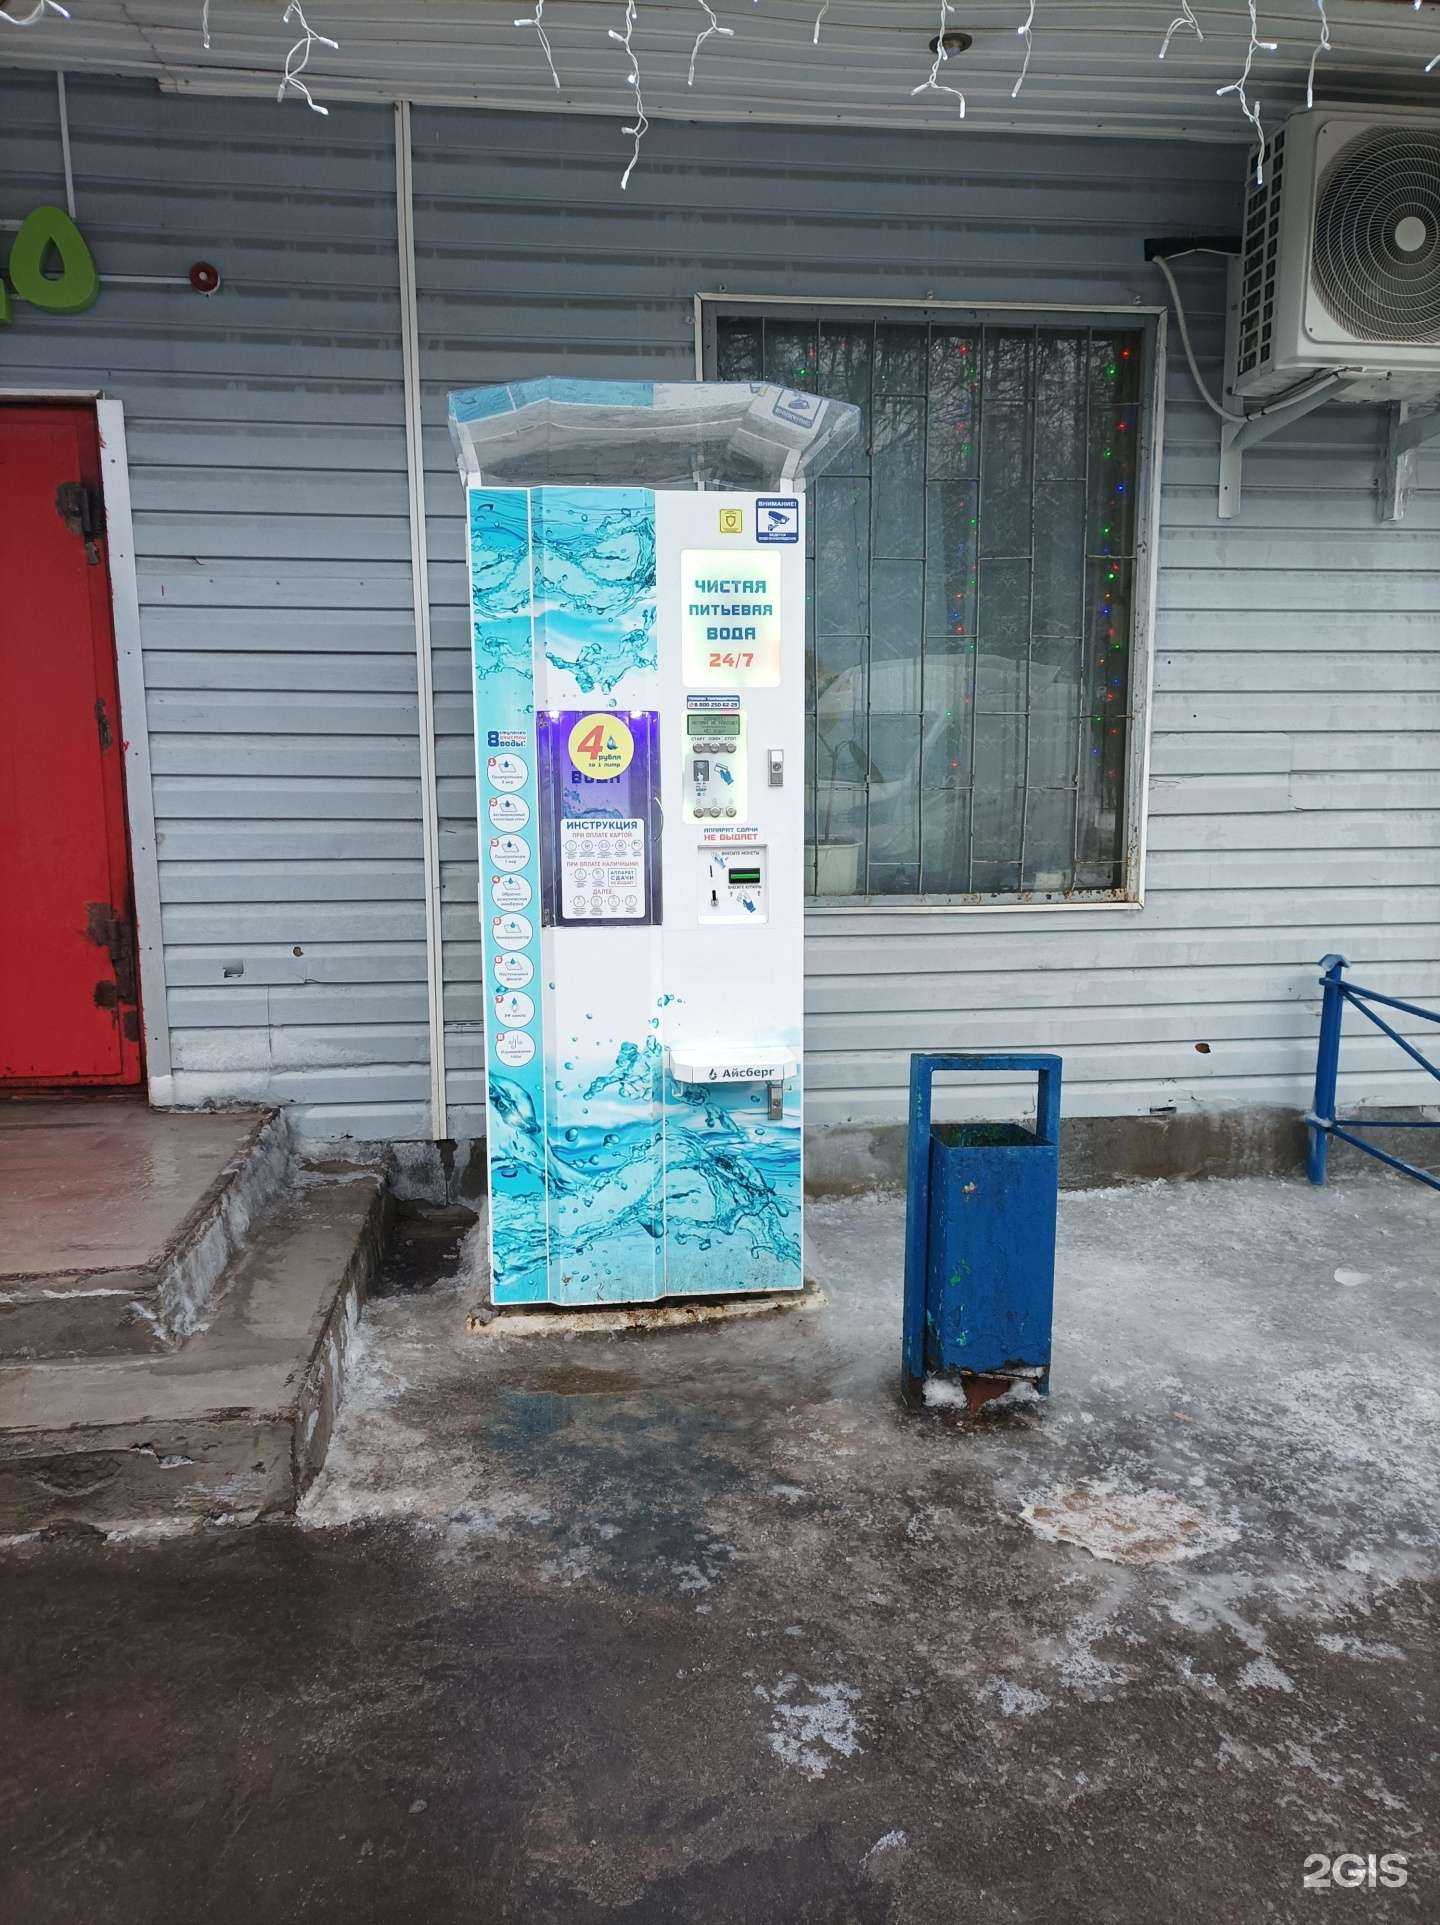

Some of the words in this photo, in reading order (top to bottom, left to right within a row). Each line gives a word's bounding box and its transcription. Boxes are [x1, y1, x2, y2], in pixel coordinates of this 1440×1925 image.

[694, 579, 766, 594] ЧИСТАЯ
[688, 604, 773, 616] ПИТЬЕВАЯ
[706, 626, 756, 640] ВОДА
[709, 653, 754, 668] 24/7
[487, 731, 499, 747] 8
[577, 724, 605, 760] 4
[566, 821, 638, 830] ИНСТРУКЦИЯ
[722, 1067, 775, 1078] Айсберг
